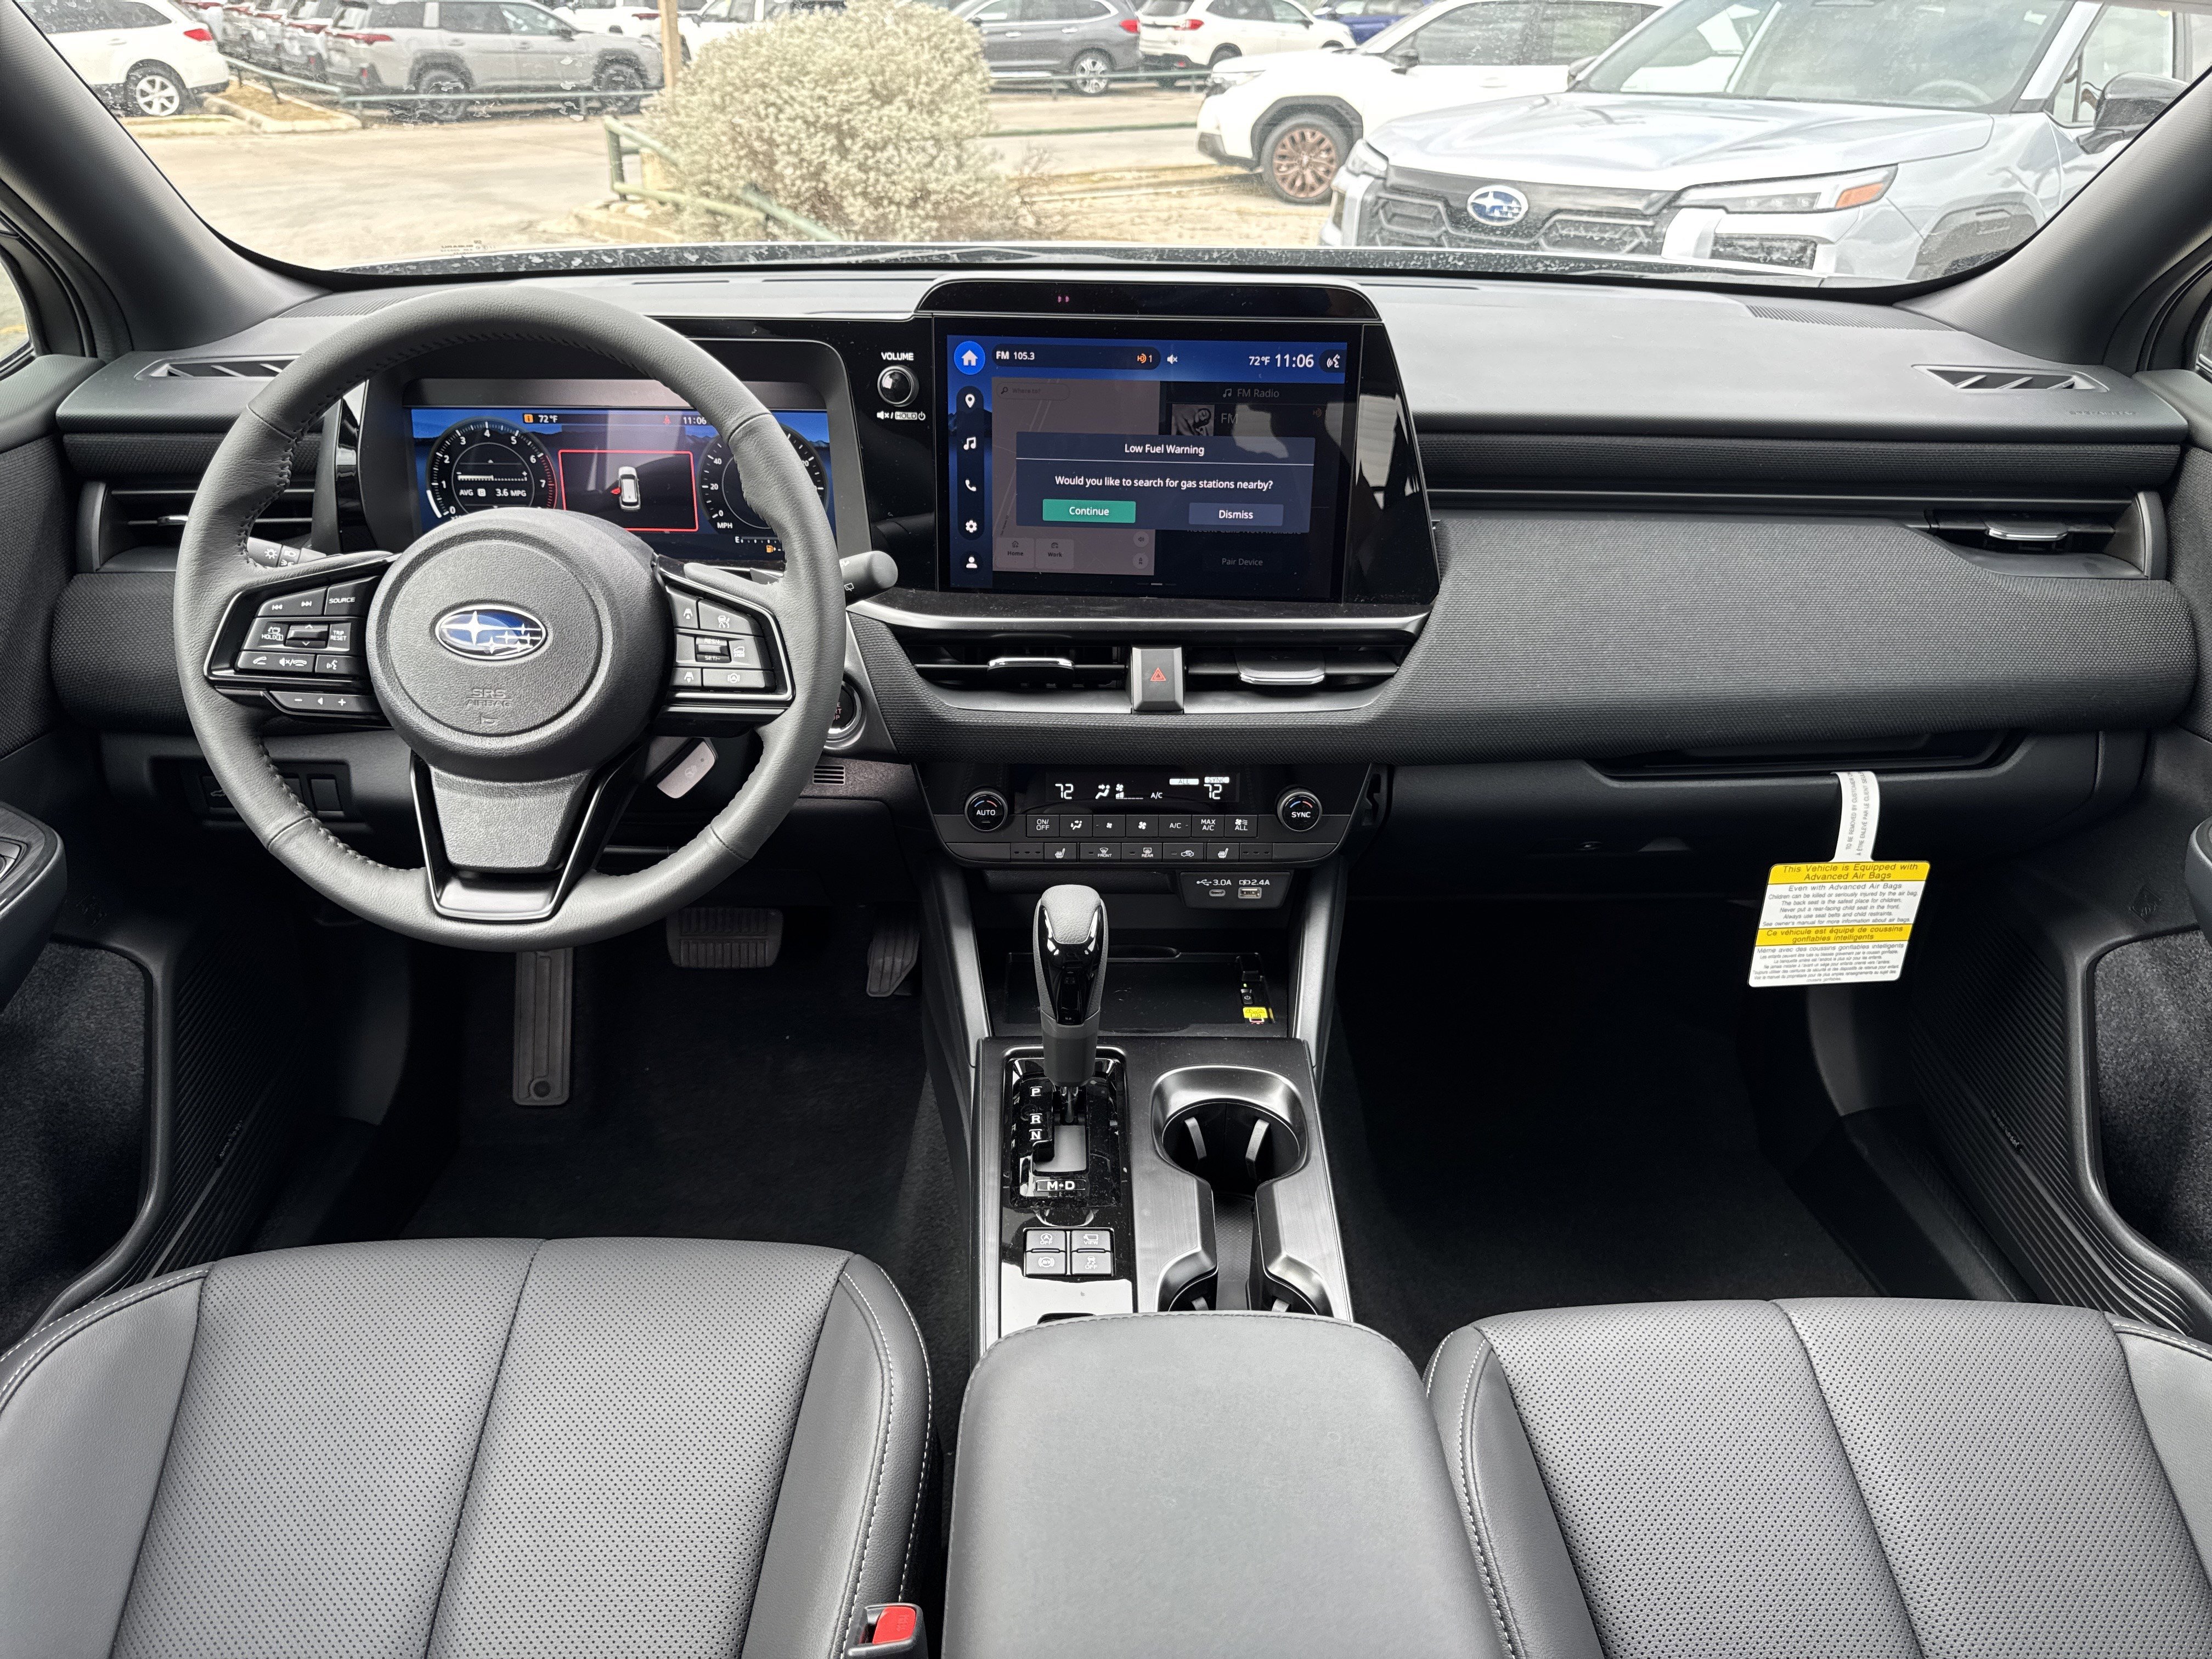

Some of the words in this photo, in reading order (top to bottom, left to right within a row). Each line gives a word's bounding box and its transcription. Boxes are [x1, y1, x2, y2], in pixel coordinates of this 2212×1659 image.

[881, 352, 914, 361] VOLUME
[996, 351, 1009, 360] FM
[1014, 352, 1035, 360] 105.3
[1249, 356, 1271, 366] 72°F
[1275, 353, 1314, 368] 11:06
[1237, 389, 1251, 397] FM
[1254, 388, 1279, 398] Radio
[538, 415, 558, 423] 72°F
[683, 416, 707, 425] 11:06
[1221, 413, 1238, 424] FM
[460, 437, 466, 445] 3
[511, 436, 517, 444] 5
[1125, 443, 1143, 453] Low
[1145, 444, 1164, 454] Fuel
[1166, 445, 1205, 456] Warning
[443, 455, 450, 464] 2
[529, 455, 537, 464] 6
[539, 479, 546, 488] 7
[1055, 475, 1084, 486] Would
[1086, 477, 1102, 487] you
[1105, 476, 1120, 487] like
[1122, 478, 1132, 487] to
[1133, 477, 1164, 487] search
[1165, 478, 1179, 488] for
[1181, 481, 1197, 490] gas
[1199, 479, 1234, 489] stations
[1237, 480, 1273, 492] nearby?
[495, 488, 509, 497] 3.6
[449, 506, 456, 514] 0
[1069, 506, 1109, 516] Continue
[1218, 510, 1253, 520] Dismiss
[1238, 558, 1263, 566] Device
[472, 688, 505, 698] SRS
[1055, 783, 1074, 799] 72
[1204, 784, 1222, 800] 72
[1806, 864, 1838, 872] Vehicle
[1853, 864, 1897, 872] Equipped
[1869, 872, 1892, 881] Bags
[1031, 1131, 1041, 1139] N
